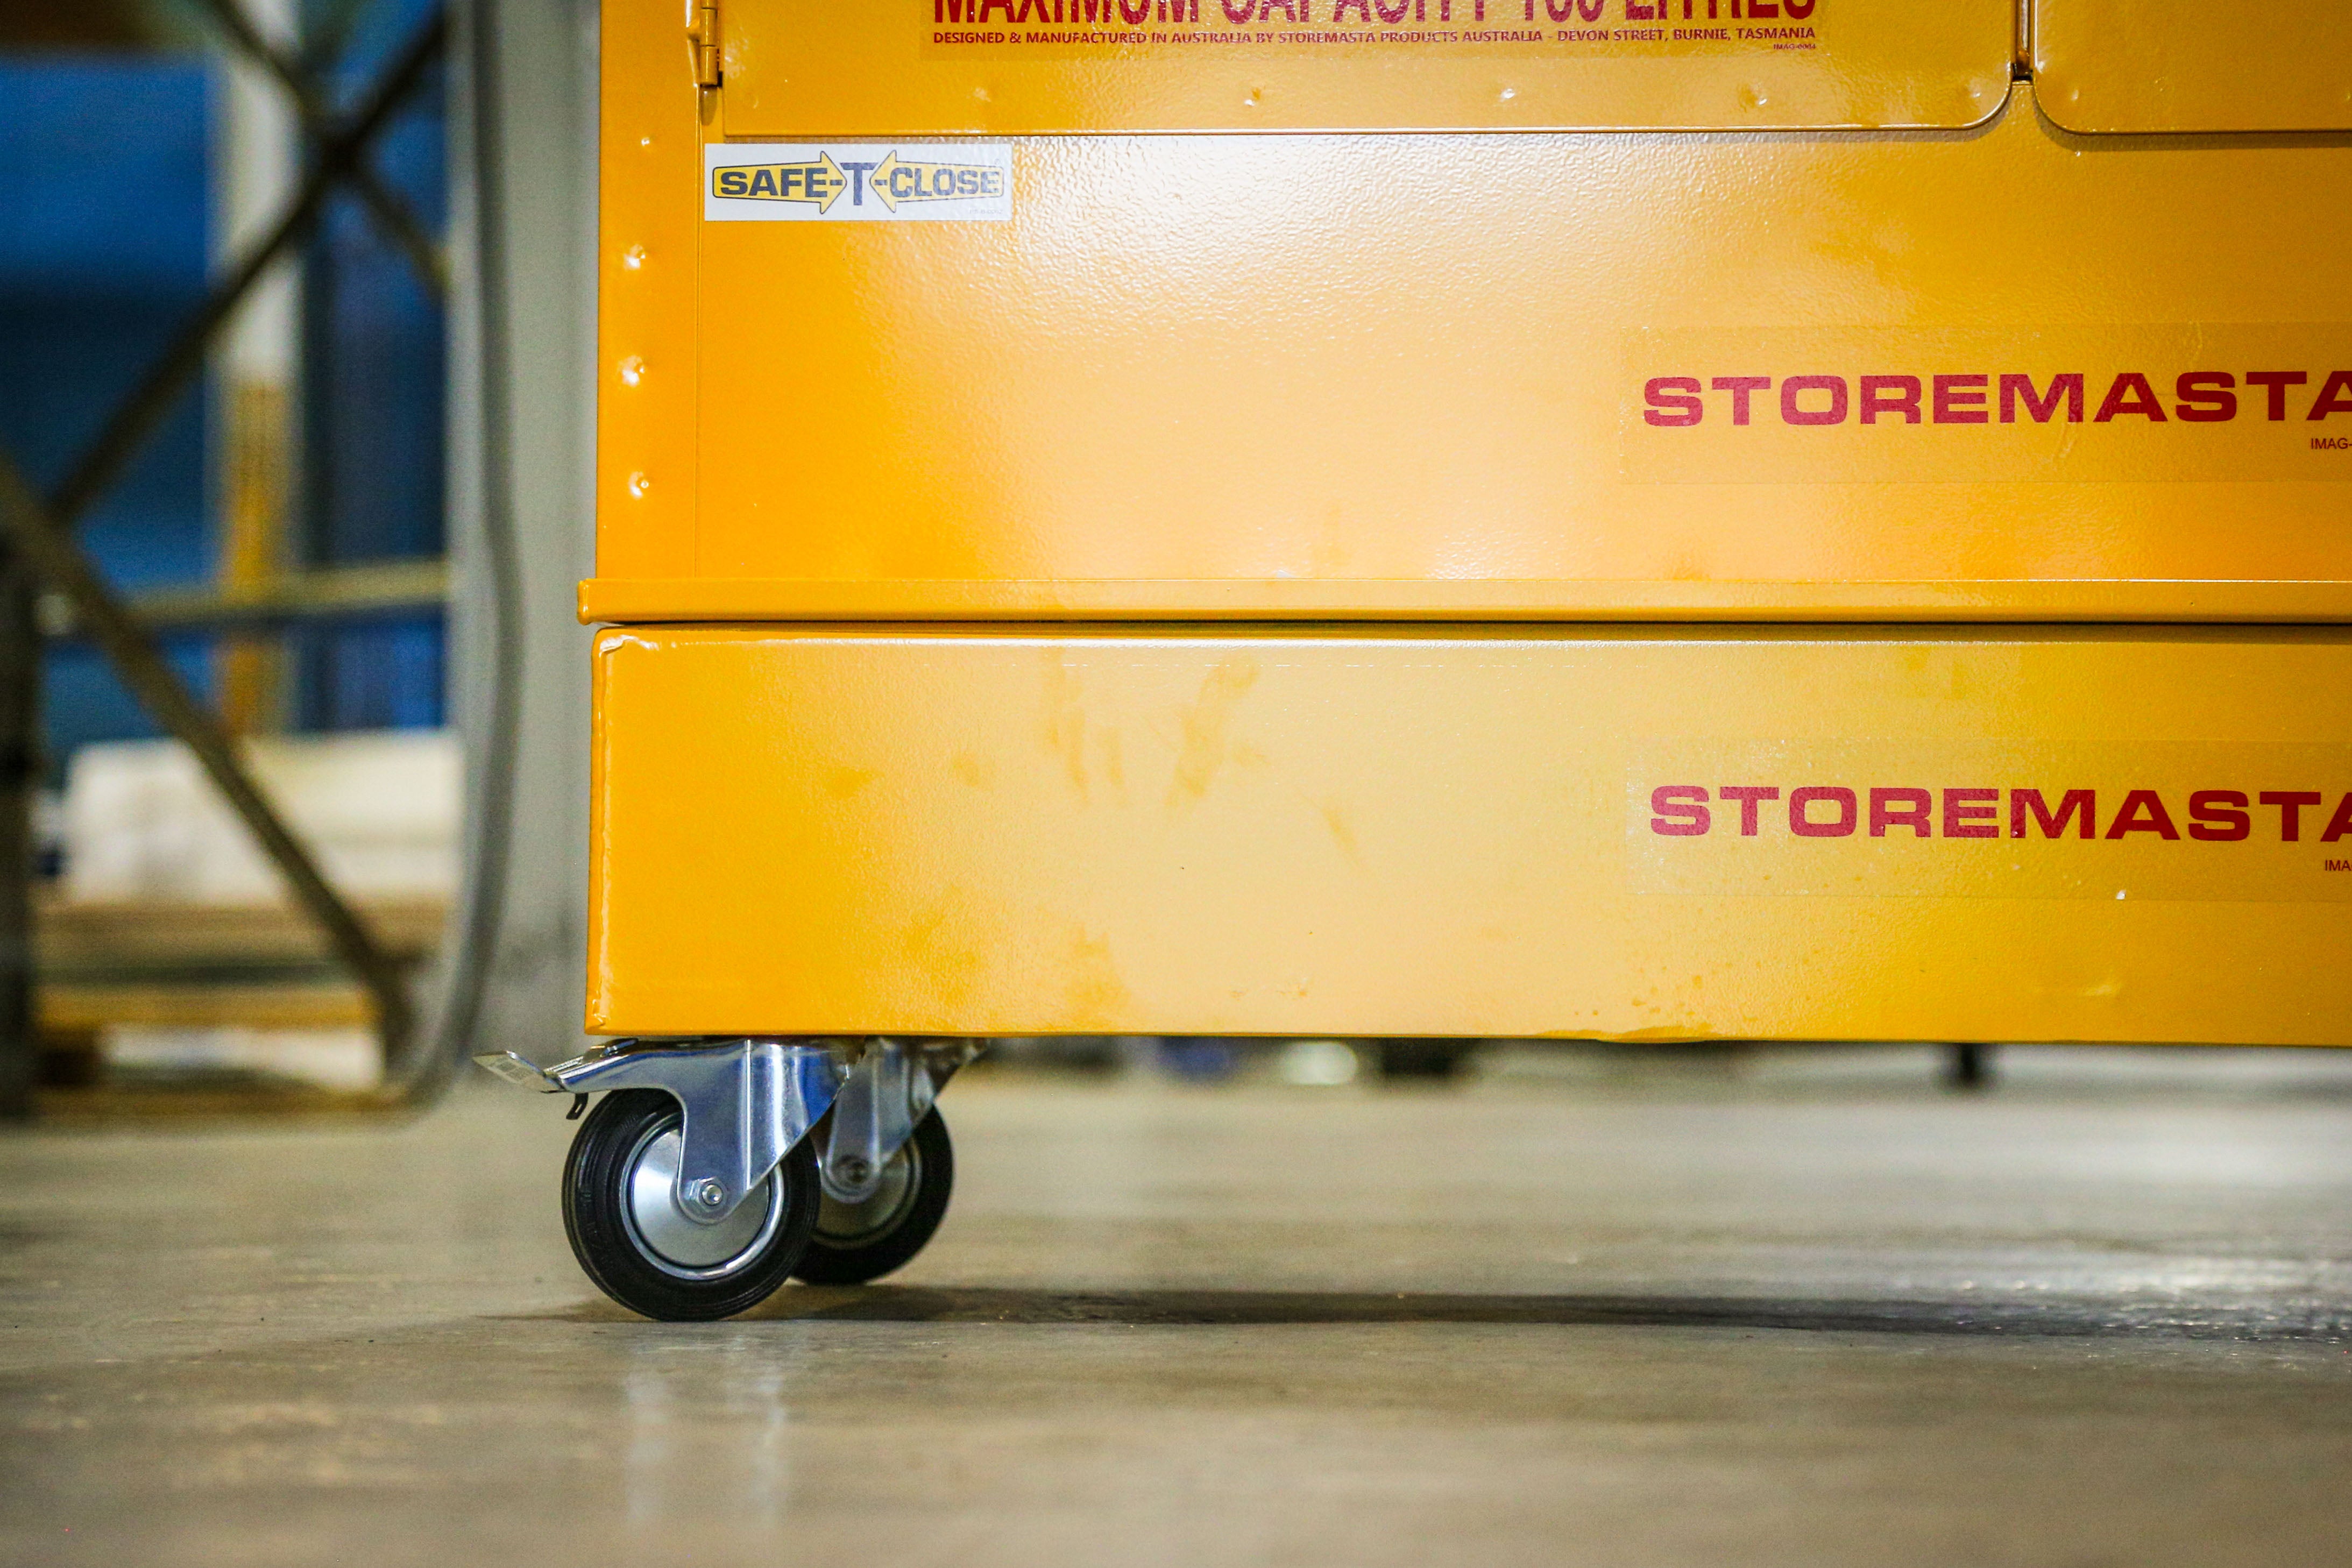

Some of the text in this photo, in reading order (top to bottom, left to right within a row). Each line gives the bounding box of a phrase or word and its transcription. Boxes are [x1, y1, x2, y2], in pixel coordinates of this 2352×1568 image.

[933, 32, 1005, 44] DESIGNED
[1009, 32, 1022, 44] &
[1026, 32, 1146, 44] MANUFACTURED
[1151, 32, 1167, 43] IN
[1172, 32, 1251, 43] AUSTRALIA
[1257, 32, 1273, 42] BY
[1279, 32, 1376, 43] STOREMASTA
[1380, 31, 1457, 42] PRODUCTS
[1462, 31, 1542, 42] AUSTRALIA
[1558, 30, 1609, 41] DEVON
[1613, 29, 1668, 42] STREET,
[1673, 29, 1731, 41] BURNIE,
[1735, 27, 1816, 39] TASMANIA
[2325, 860, 2352, 872] IMA
